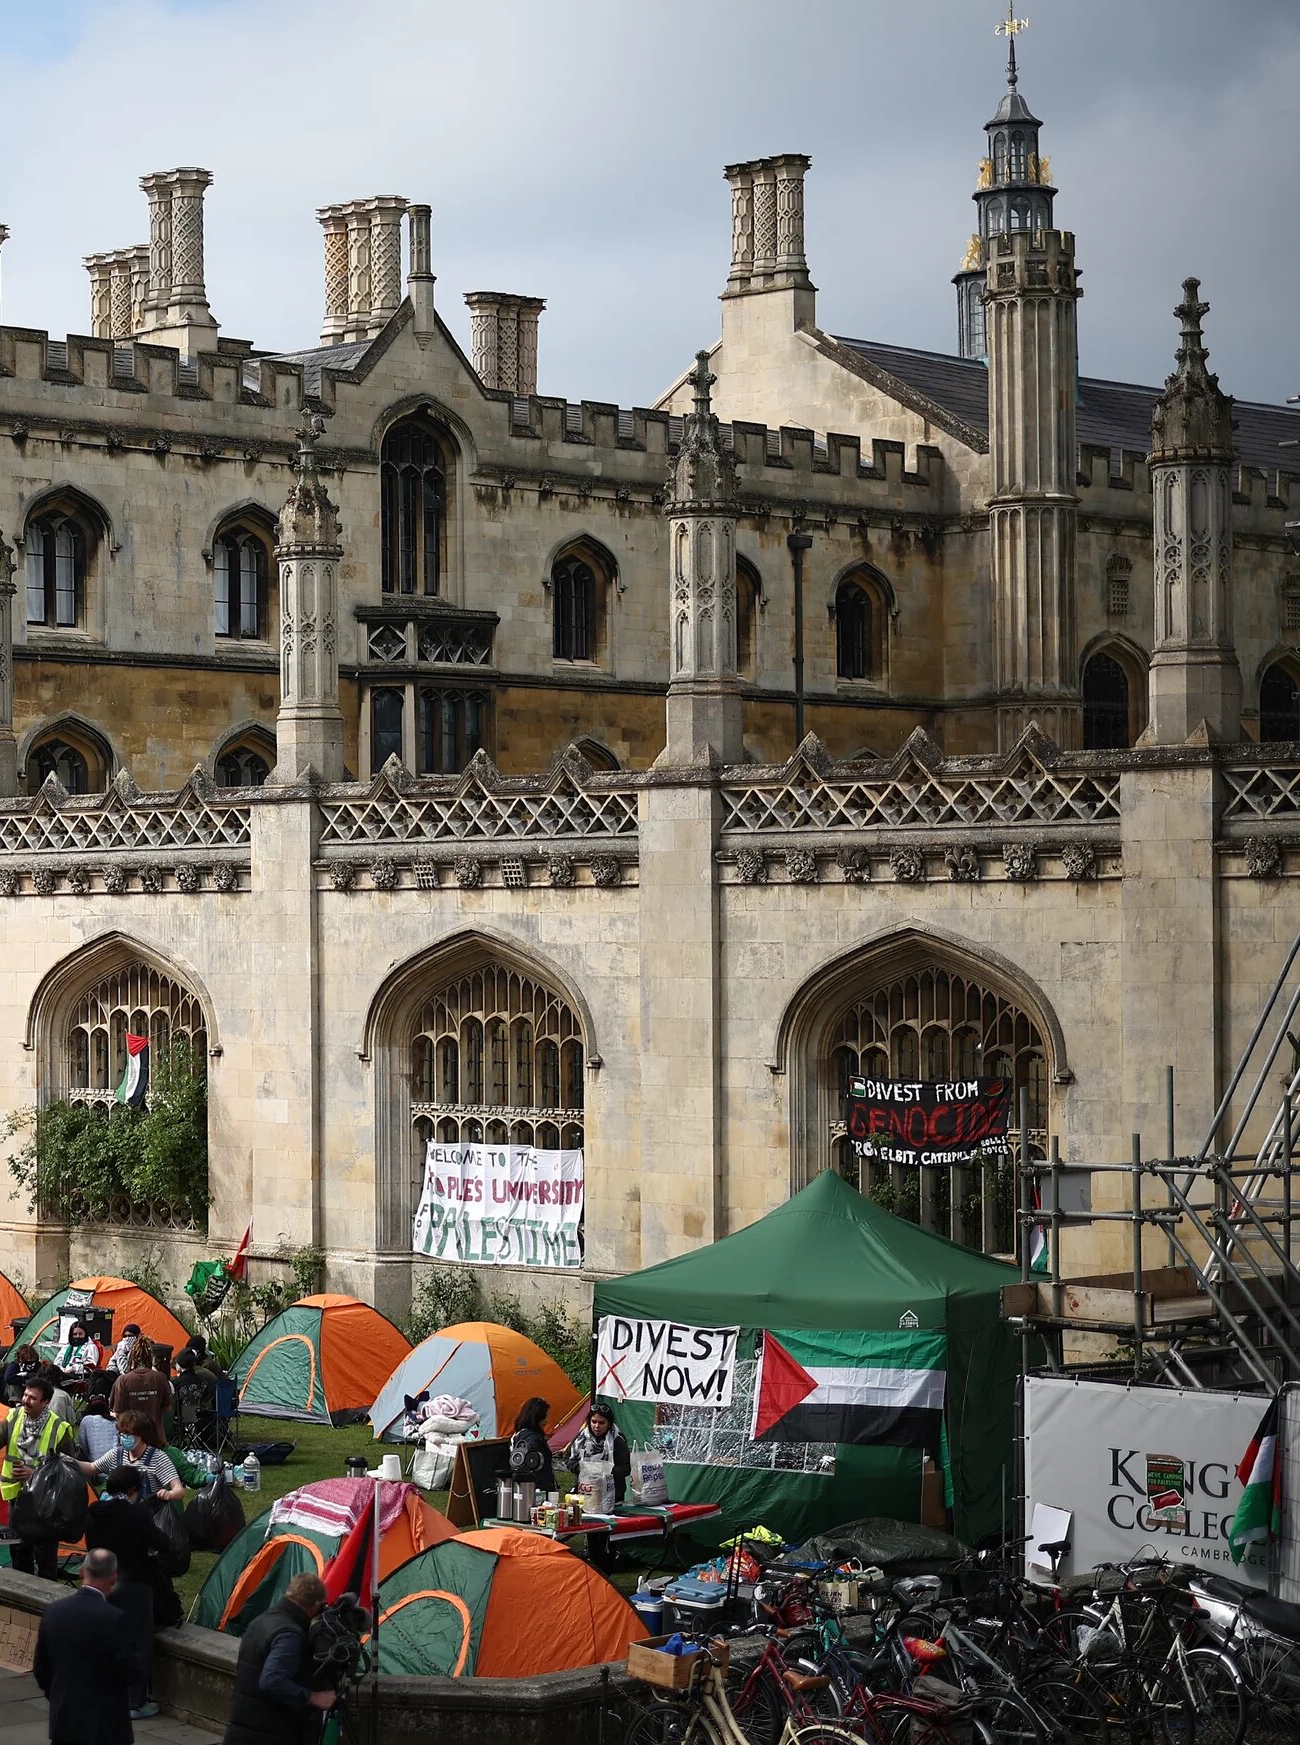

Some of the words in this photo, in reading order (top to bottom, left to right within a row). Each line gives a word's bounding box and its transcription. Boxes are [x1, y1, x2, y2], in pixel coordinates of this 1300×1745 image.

[866, 1080, 923, 1102] DIVEST
[935, 1080, 979, 1103] FROM
[849, 1097, 1008, 1148] GENOCIDE
[487, 1152, 506, 1168] TO
[516, 1152, 538, 1171] THE
[879, 1146, 919, 1166] ELBIT,
[491, 1178, 585, 1206] UNIVERSITY
[422, 1202, 580, 1267] PALESTINE
[612, 1319, 737, 1362] DIVEST
[642, 1363, 729, 1402] NOW!
